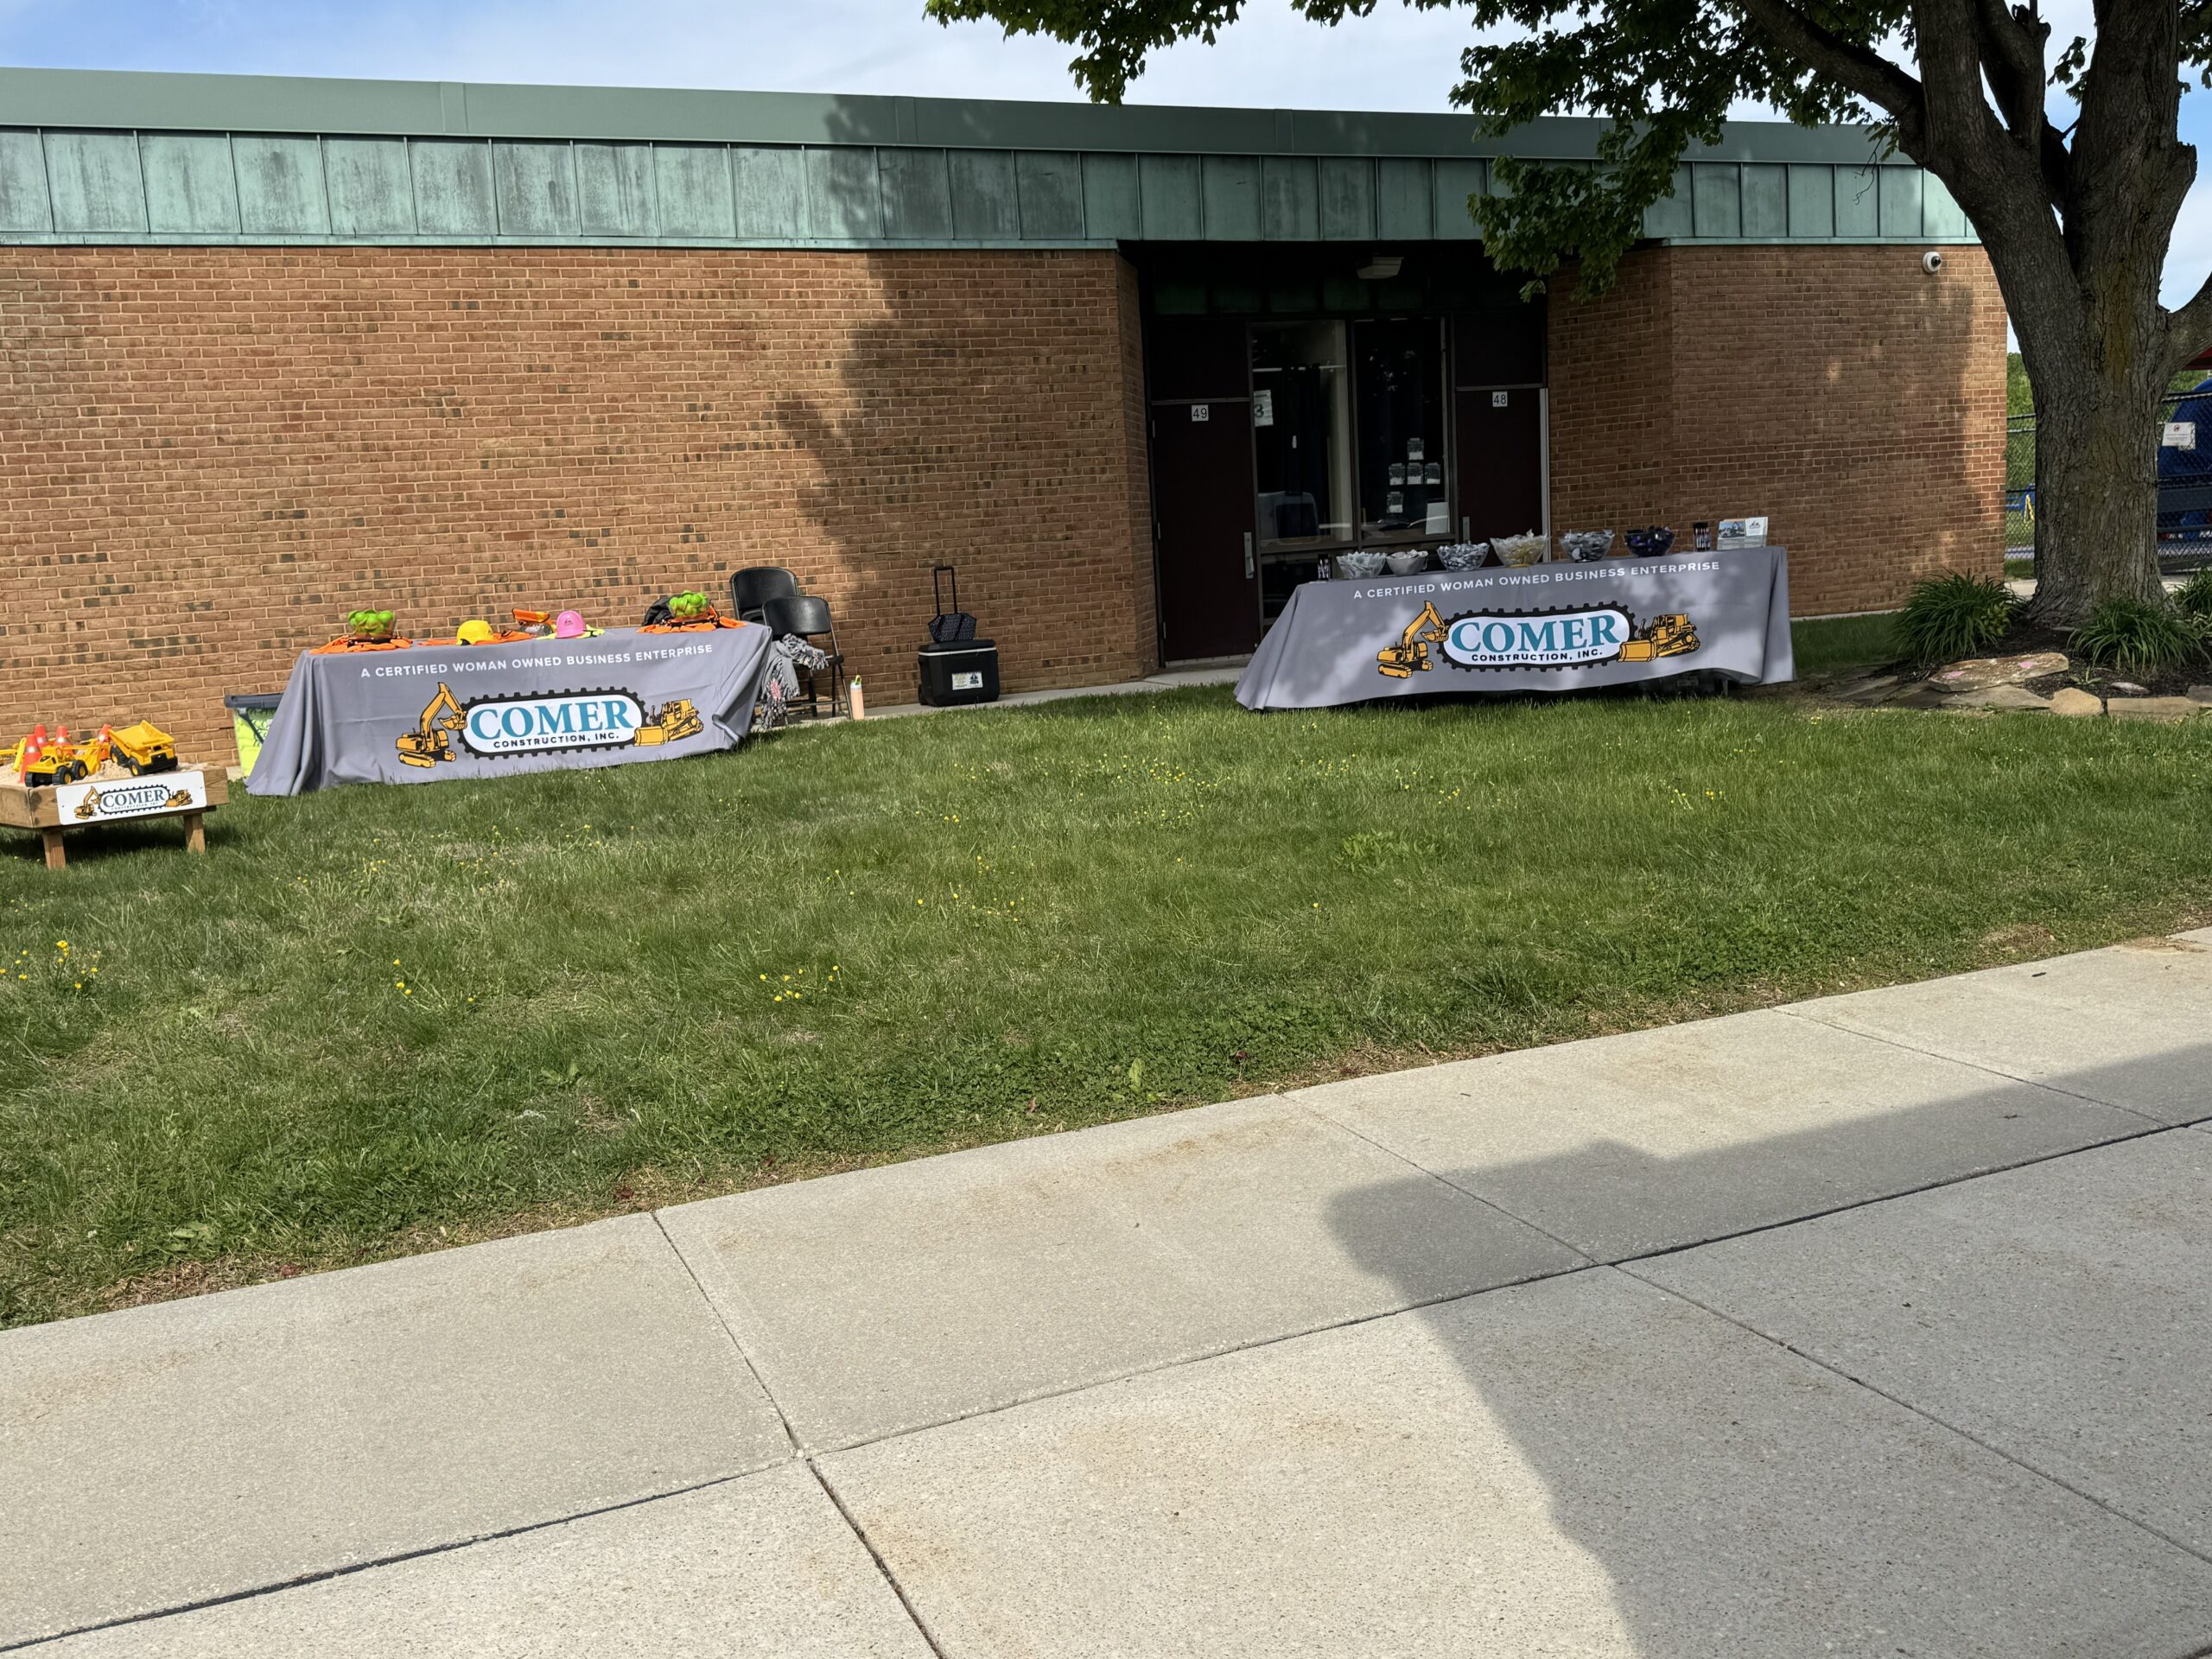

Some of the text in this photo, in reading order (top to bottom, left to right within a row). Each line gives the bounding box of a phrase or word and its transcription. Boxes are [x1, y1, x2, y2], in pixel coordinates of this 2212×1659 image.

[1494, 394, 1506, 404] 48
[1192, 407, 1208, 419] 49
[1353, 562, 1720, 599] A CERTIFIED WOMAN OWNED BUSINESS ENTERPRISE
[1451, 614, 1620, 653] COMER
[360, 645, 713, 678] A CERTIFIED WOMAN OWNED BUSINESS ENTERPRISE
[1471, 649, 1603, 662] CONSTRUCTION, INC.
[470, 700, 634, 741] COMER
[493, 736, 591, 748] CONSTRUCTION,
[103, 789, 165, 807] COMER
